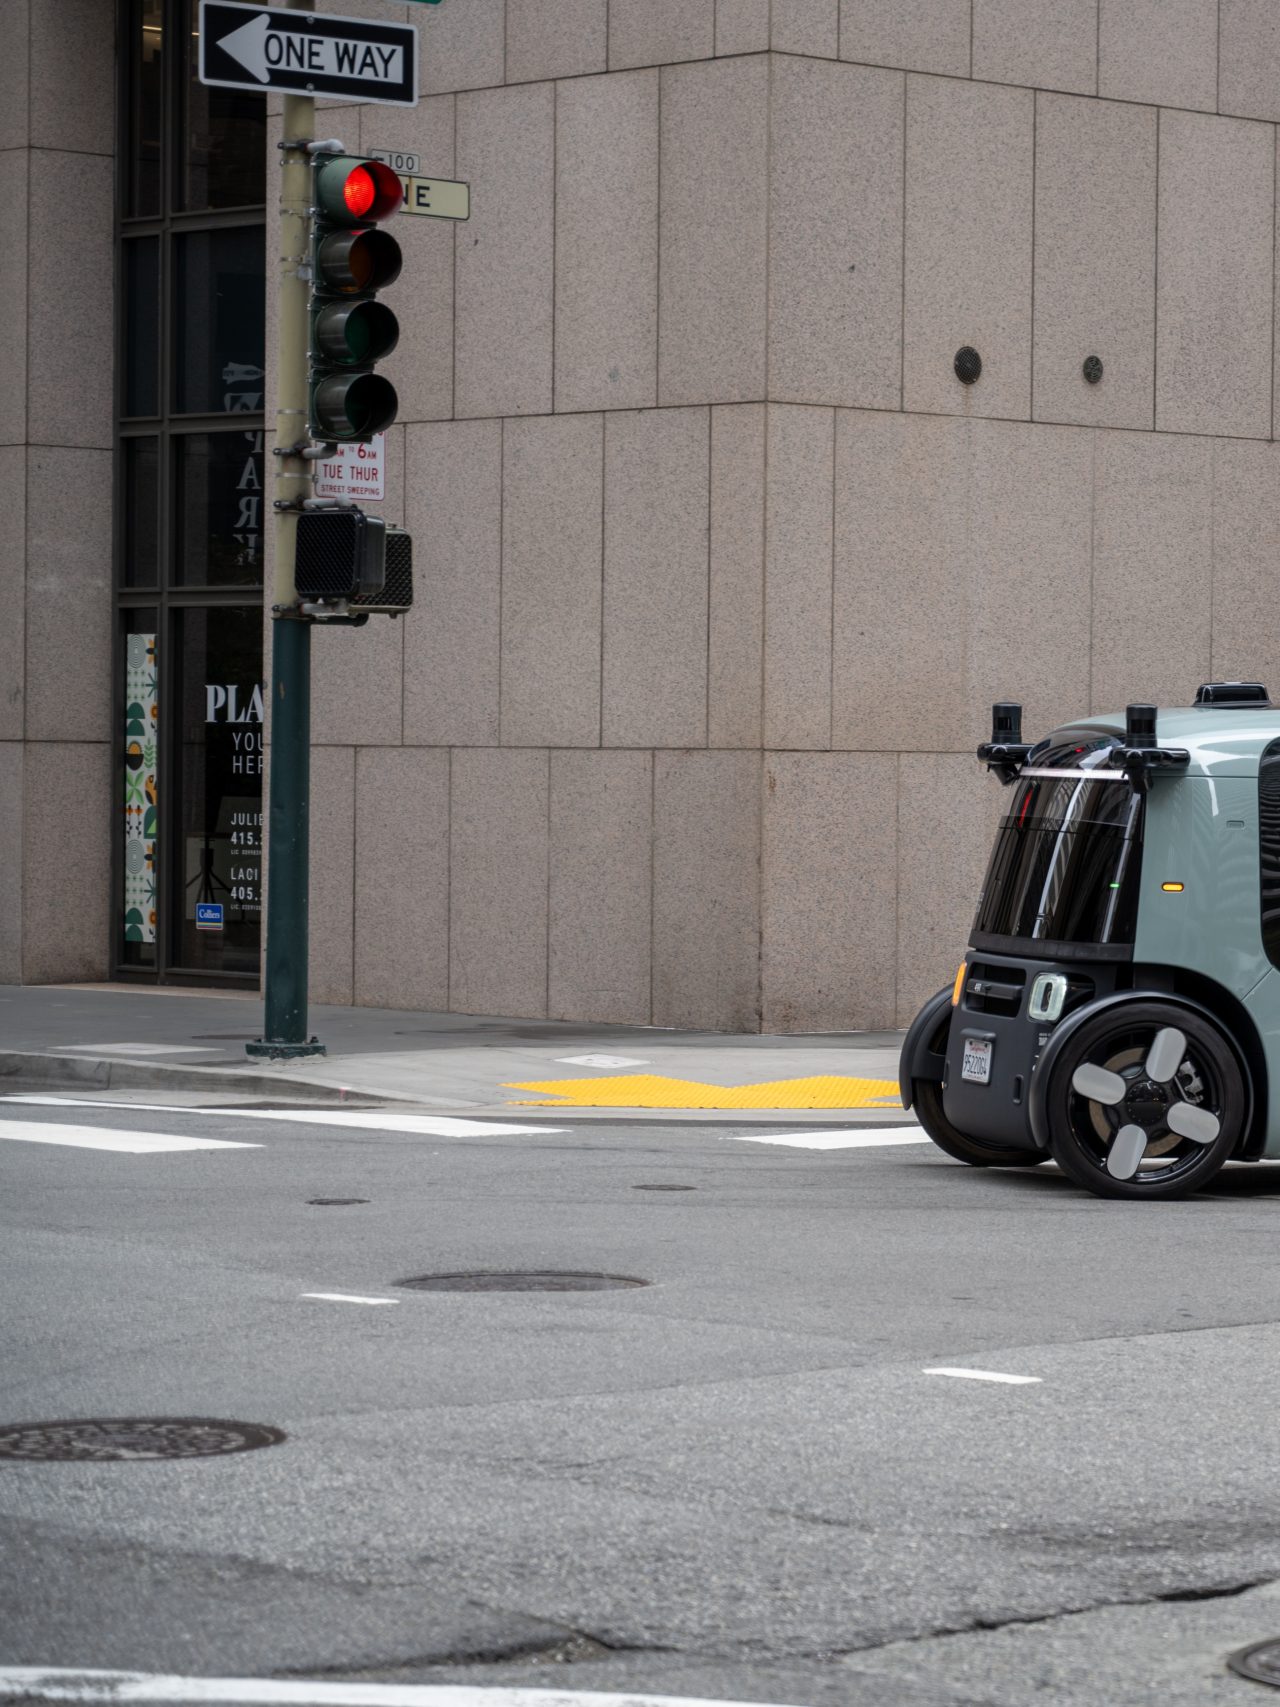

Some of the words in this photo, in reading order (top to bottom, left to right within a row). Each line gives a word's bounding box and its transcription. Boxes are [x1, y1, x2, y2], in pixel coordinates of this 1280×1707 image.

[264, 33, 325, 71] ONE
[334, 41, 397, 79] WAY
[388, 154, 415, 171] 100
[323, 464, 343, 480] TUE
[350, 466, 379, 482] THUR
[321, 484, 345, 493] STREET
[347, 486, 380, 496] SWEEPING
[204, 684, 264, 723] PLA
[231, 886, 263, 901] 405.
